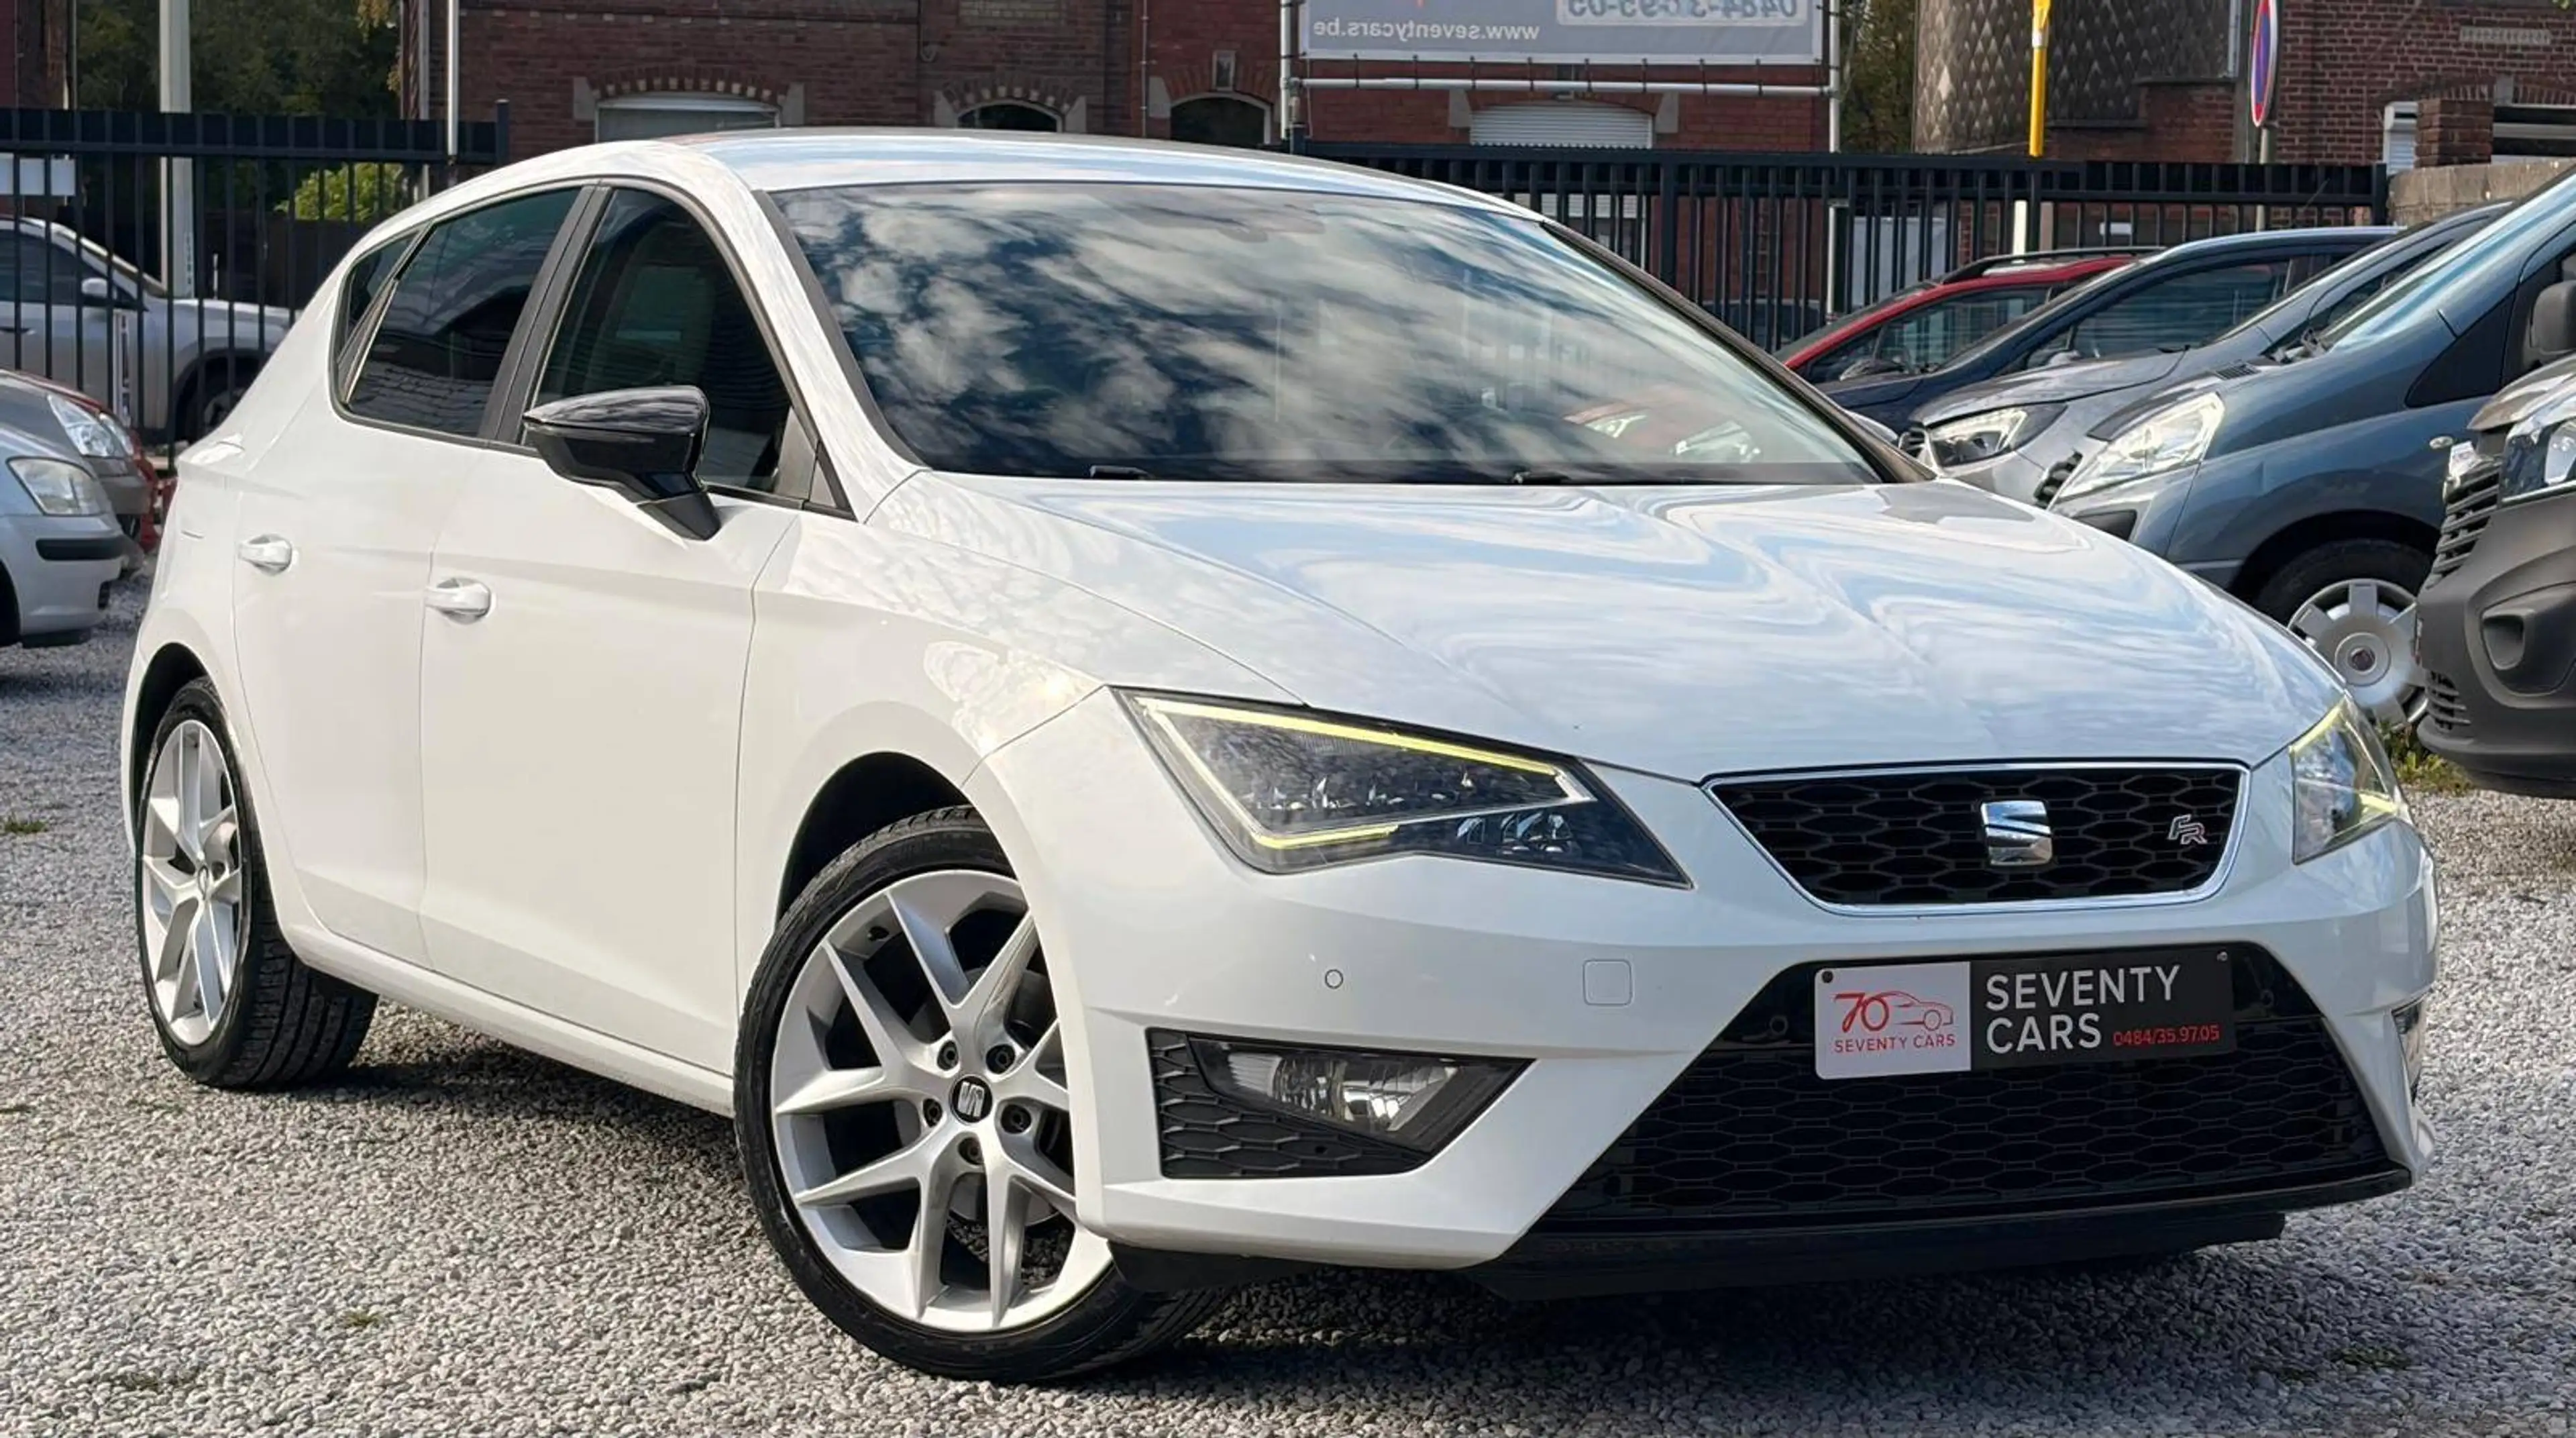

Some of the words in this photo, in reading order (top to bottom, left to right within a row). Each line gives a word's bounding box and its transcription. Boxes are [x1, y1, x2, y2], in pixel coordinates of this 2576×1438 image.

[2167, 813, 2208, 845] FR
[1986, 964, 2181, 1011] SEVENTY
[1831, 992, 1890, 1033] 70
[1834, 1037, 1908, 1054] SEVENTY
[1913, 1033, 1957, 1049] CARS
[1986, 1013, 2102, 1055] CARS
[2112, 1024, 2220, 1047] 0484/35.97.05
